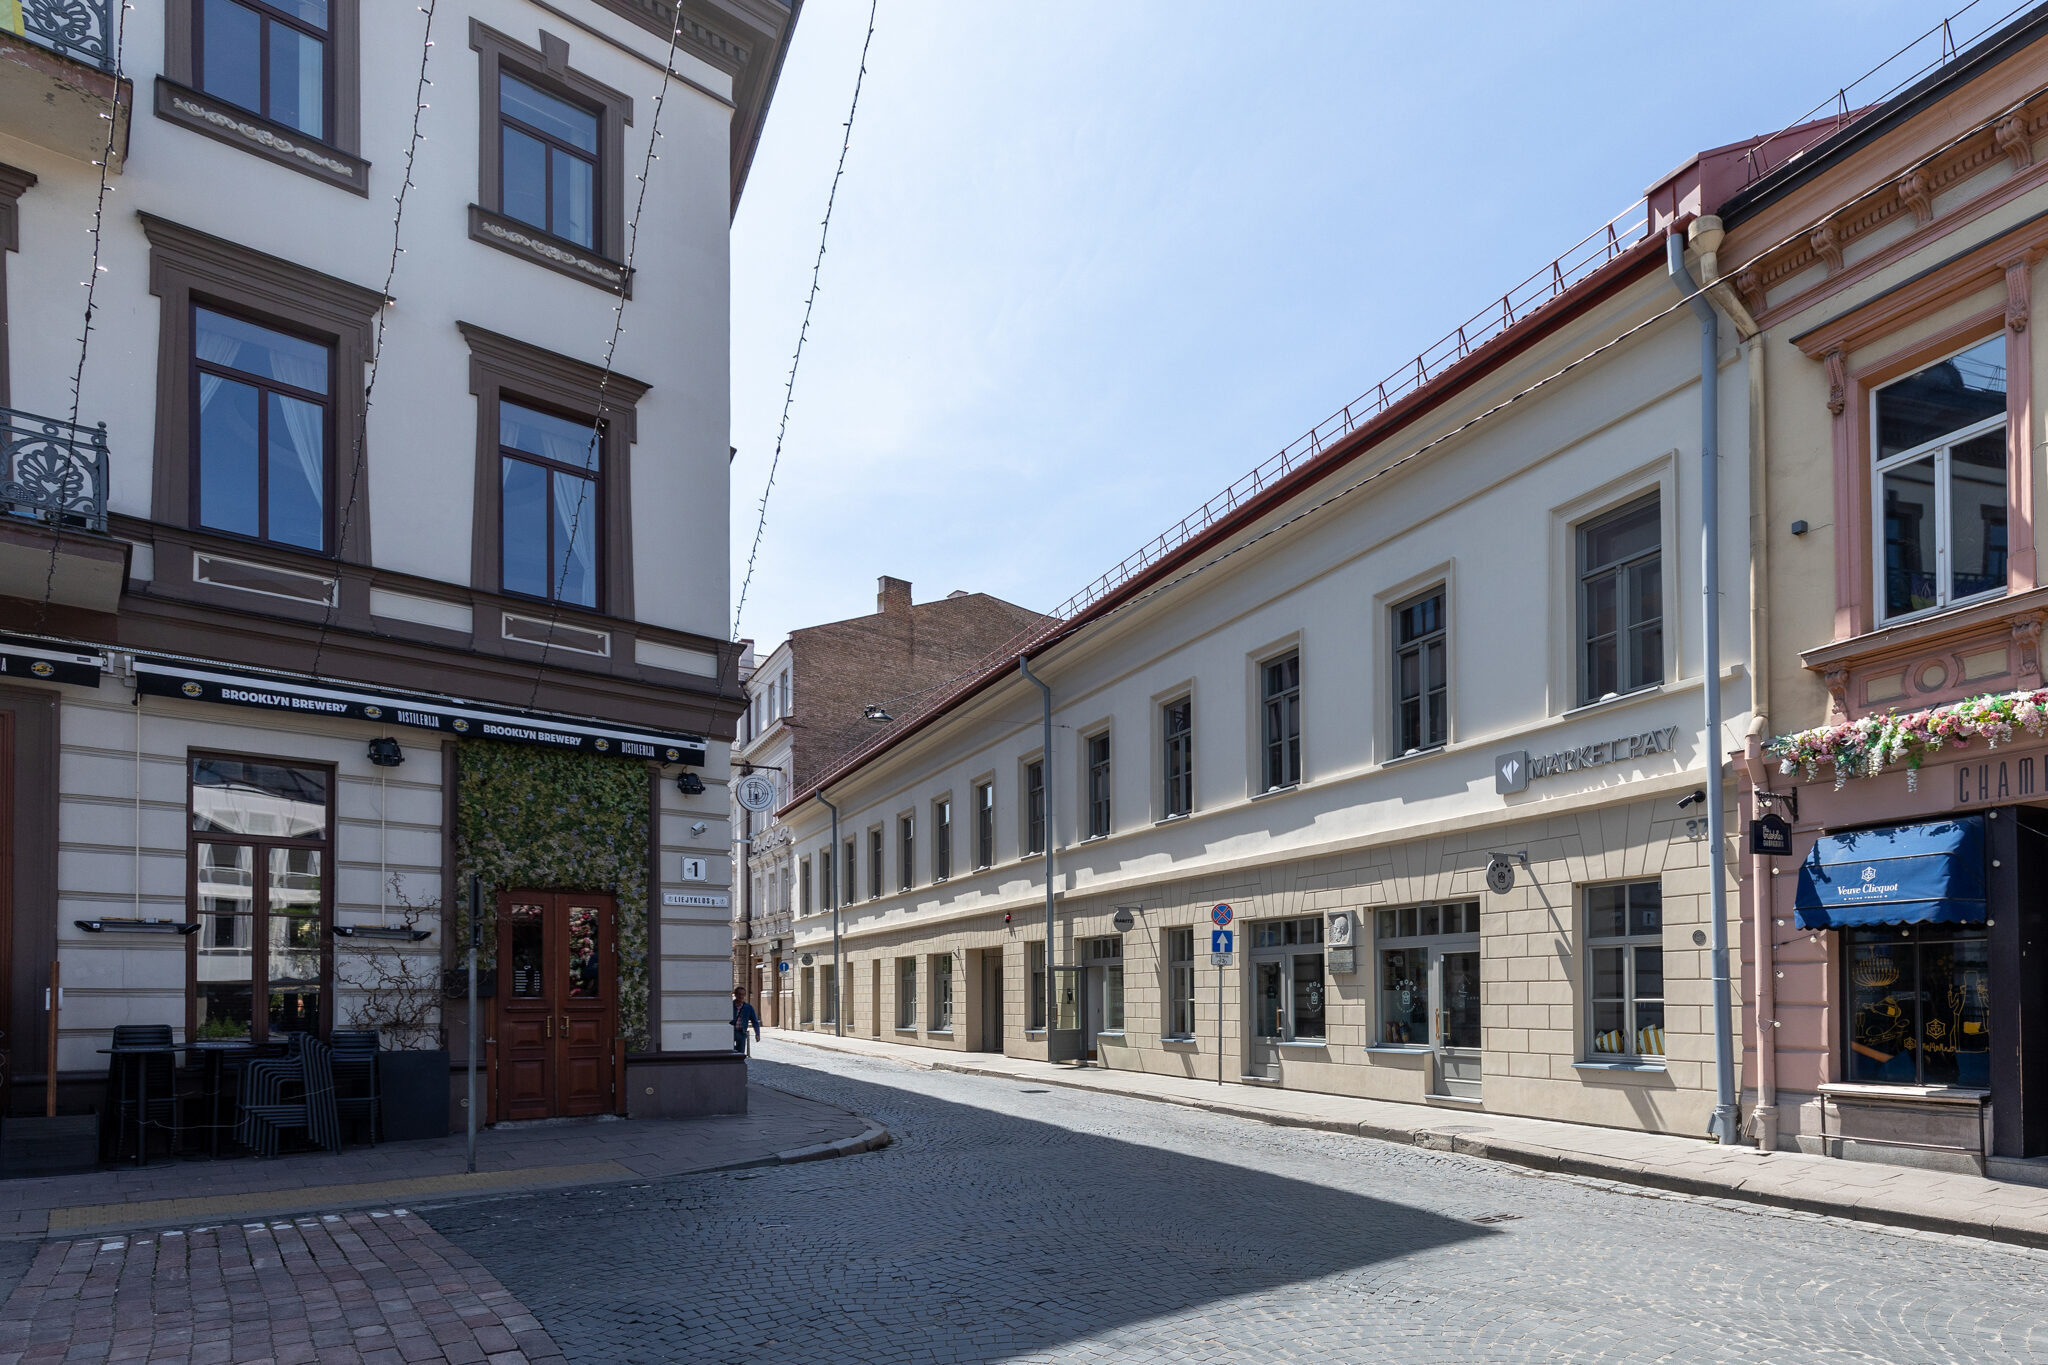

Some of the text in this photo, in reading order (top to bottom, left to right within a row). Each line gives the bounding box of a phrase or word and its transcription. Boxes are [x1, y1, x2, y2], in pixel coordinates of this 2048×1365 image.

[221, 688, 348, 713] BROOKLYN BREWERY
[397, 710, 440, 728] DISTILERIJA
[483, 724, 582, 746] BROOKLYN BREWERY
[621, 741, 655, 757] DISTILERIJA
[1528, 725, 1678, 779] MARKET PAY
[1960, 754, 2048, 803] CHAM
[692, 861, 698, 877] 1
[1837, 883, 1898, 895] Veuve Clicquot
[674, 896, 710, 904] LIEJYKLOS
